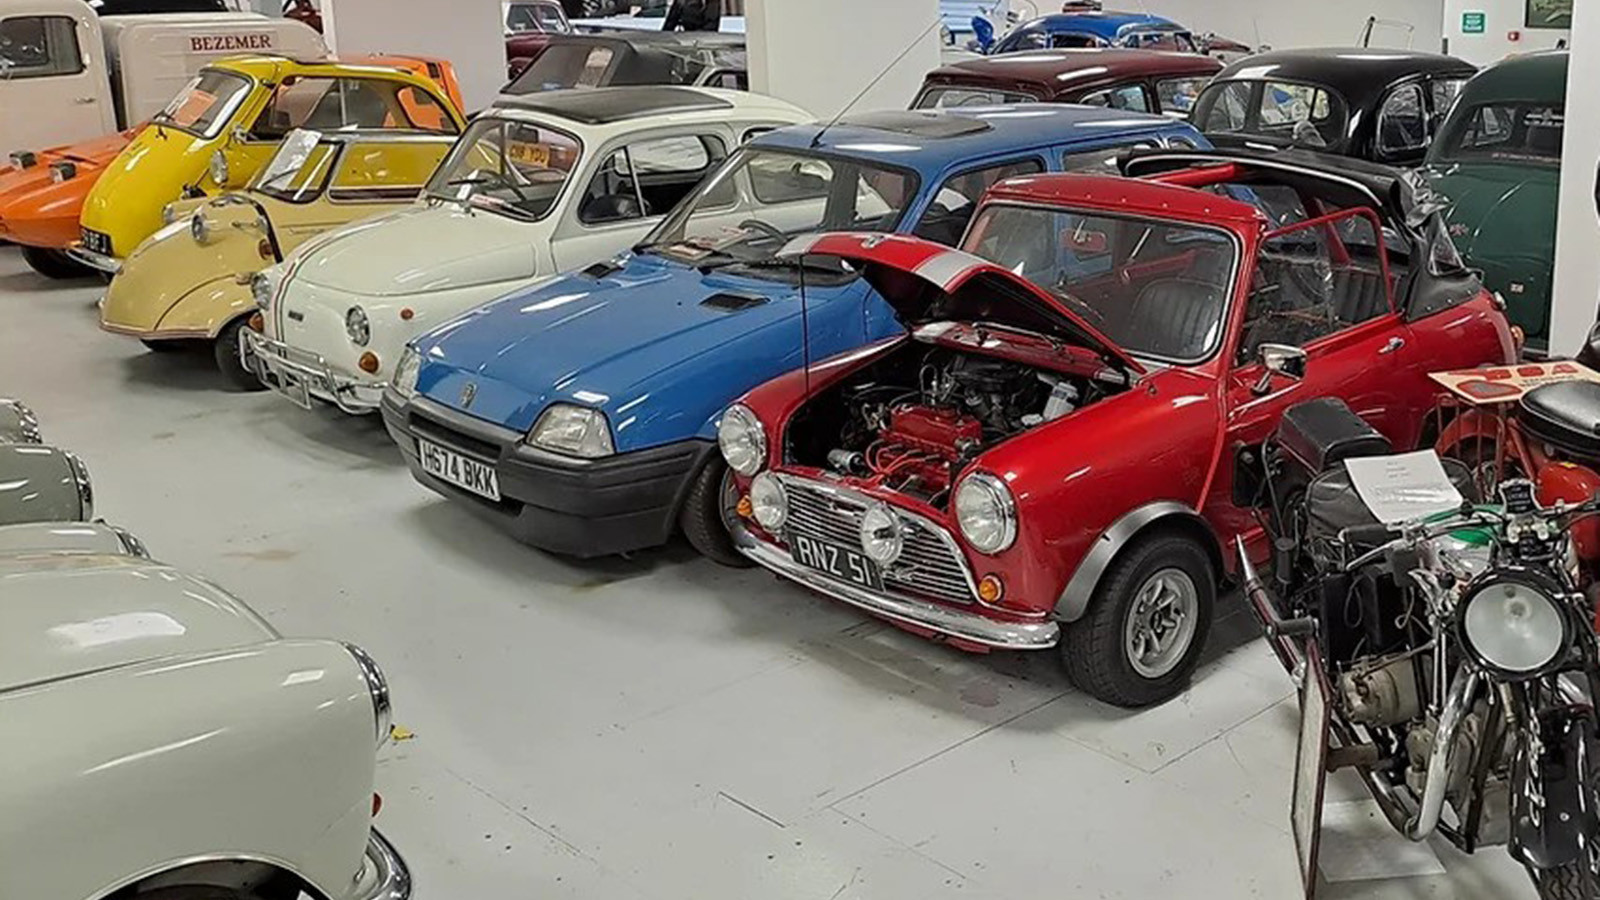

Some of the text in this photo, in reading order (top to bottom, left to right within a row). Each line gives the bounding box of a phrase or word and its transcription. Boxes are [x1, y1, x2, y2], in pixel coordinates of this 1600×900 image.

[190, 34, 272, 51] BEZEMER
[422, 441, 495, 496] H674 BKK
[796, 536, 872, 586] RNZ 51
